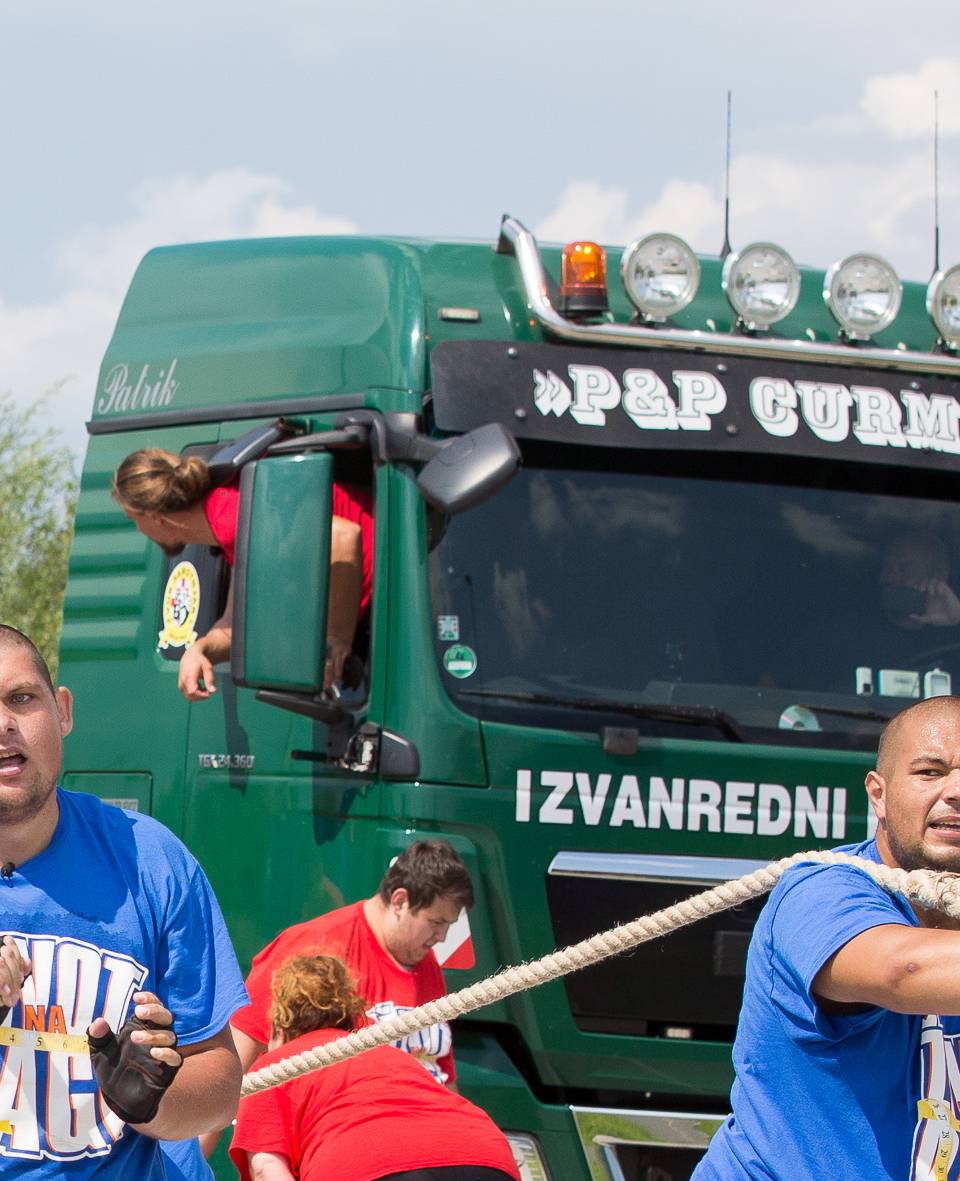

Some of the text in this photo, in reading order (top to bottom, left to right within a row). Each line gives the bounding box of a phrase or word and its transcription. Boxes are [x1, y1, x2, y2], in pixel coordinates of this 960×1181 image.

[98, 358, 180, 414] Patrik
[515, 769, 847, 840] IZVANREDNI
[24, 1004, 67, 1034] NA
